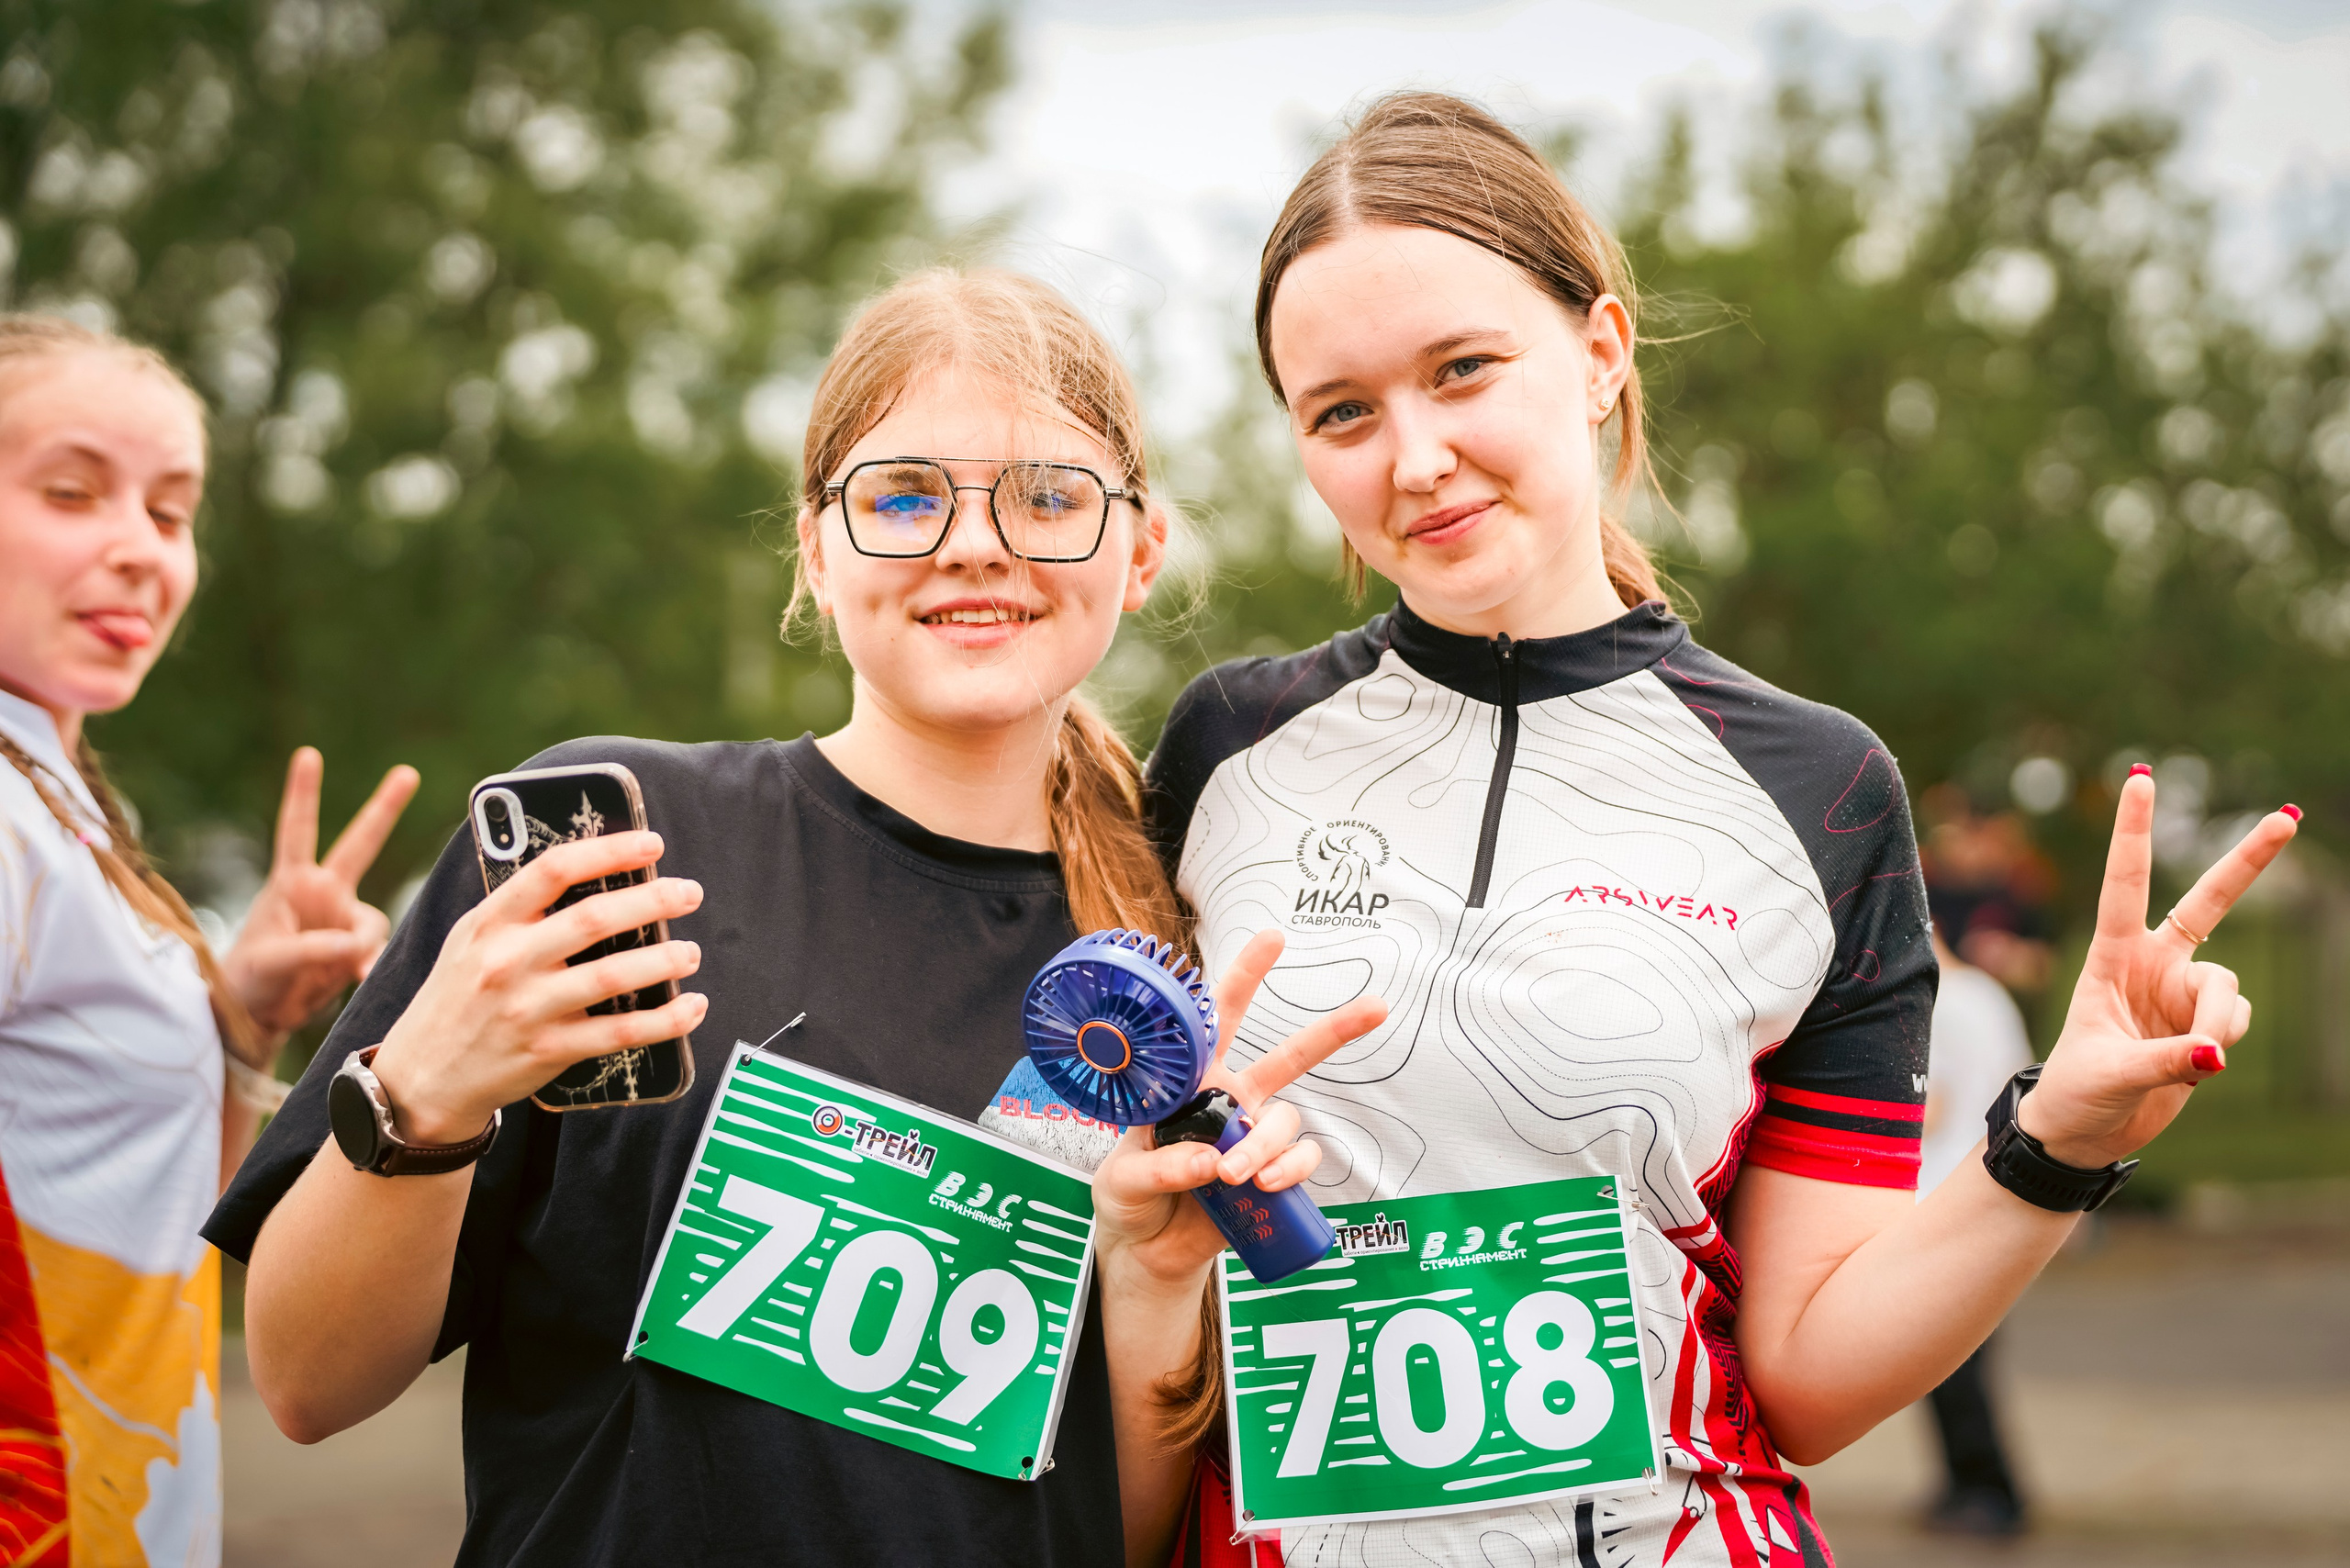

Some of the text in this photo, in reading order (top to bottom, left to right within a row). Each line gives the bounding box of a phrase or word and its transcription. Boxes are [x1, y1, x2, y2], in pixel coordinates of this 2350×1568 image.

[1296, 826, 1318, 882] СПОРТИВНОЕ
[1294, 888, 1390, 916] ИКАР
[1291, 914, 1382, 929] СТАВРОПОЛЬ
[928, 1193, 1013, 1232] СТРИЖАМЕНТ
[1334, 1214, 1407, 1250] ТРЕЙЛ
[1419, 1249, 1527, 1271] СТРИЖАМЕНТ
[676, 1174, 1039, 1426] 709
[1261, 1291, 1614, 1478] 708
